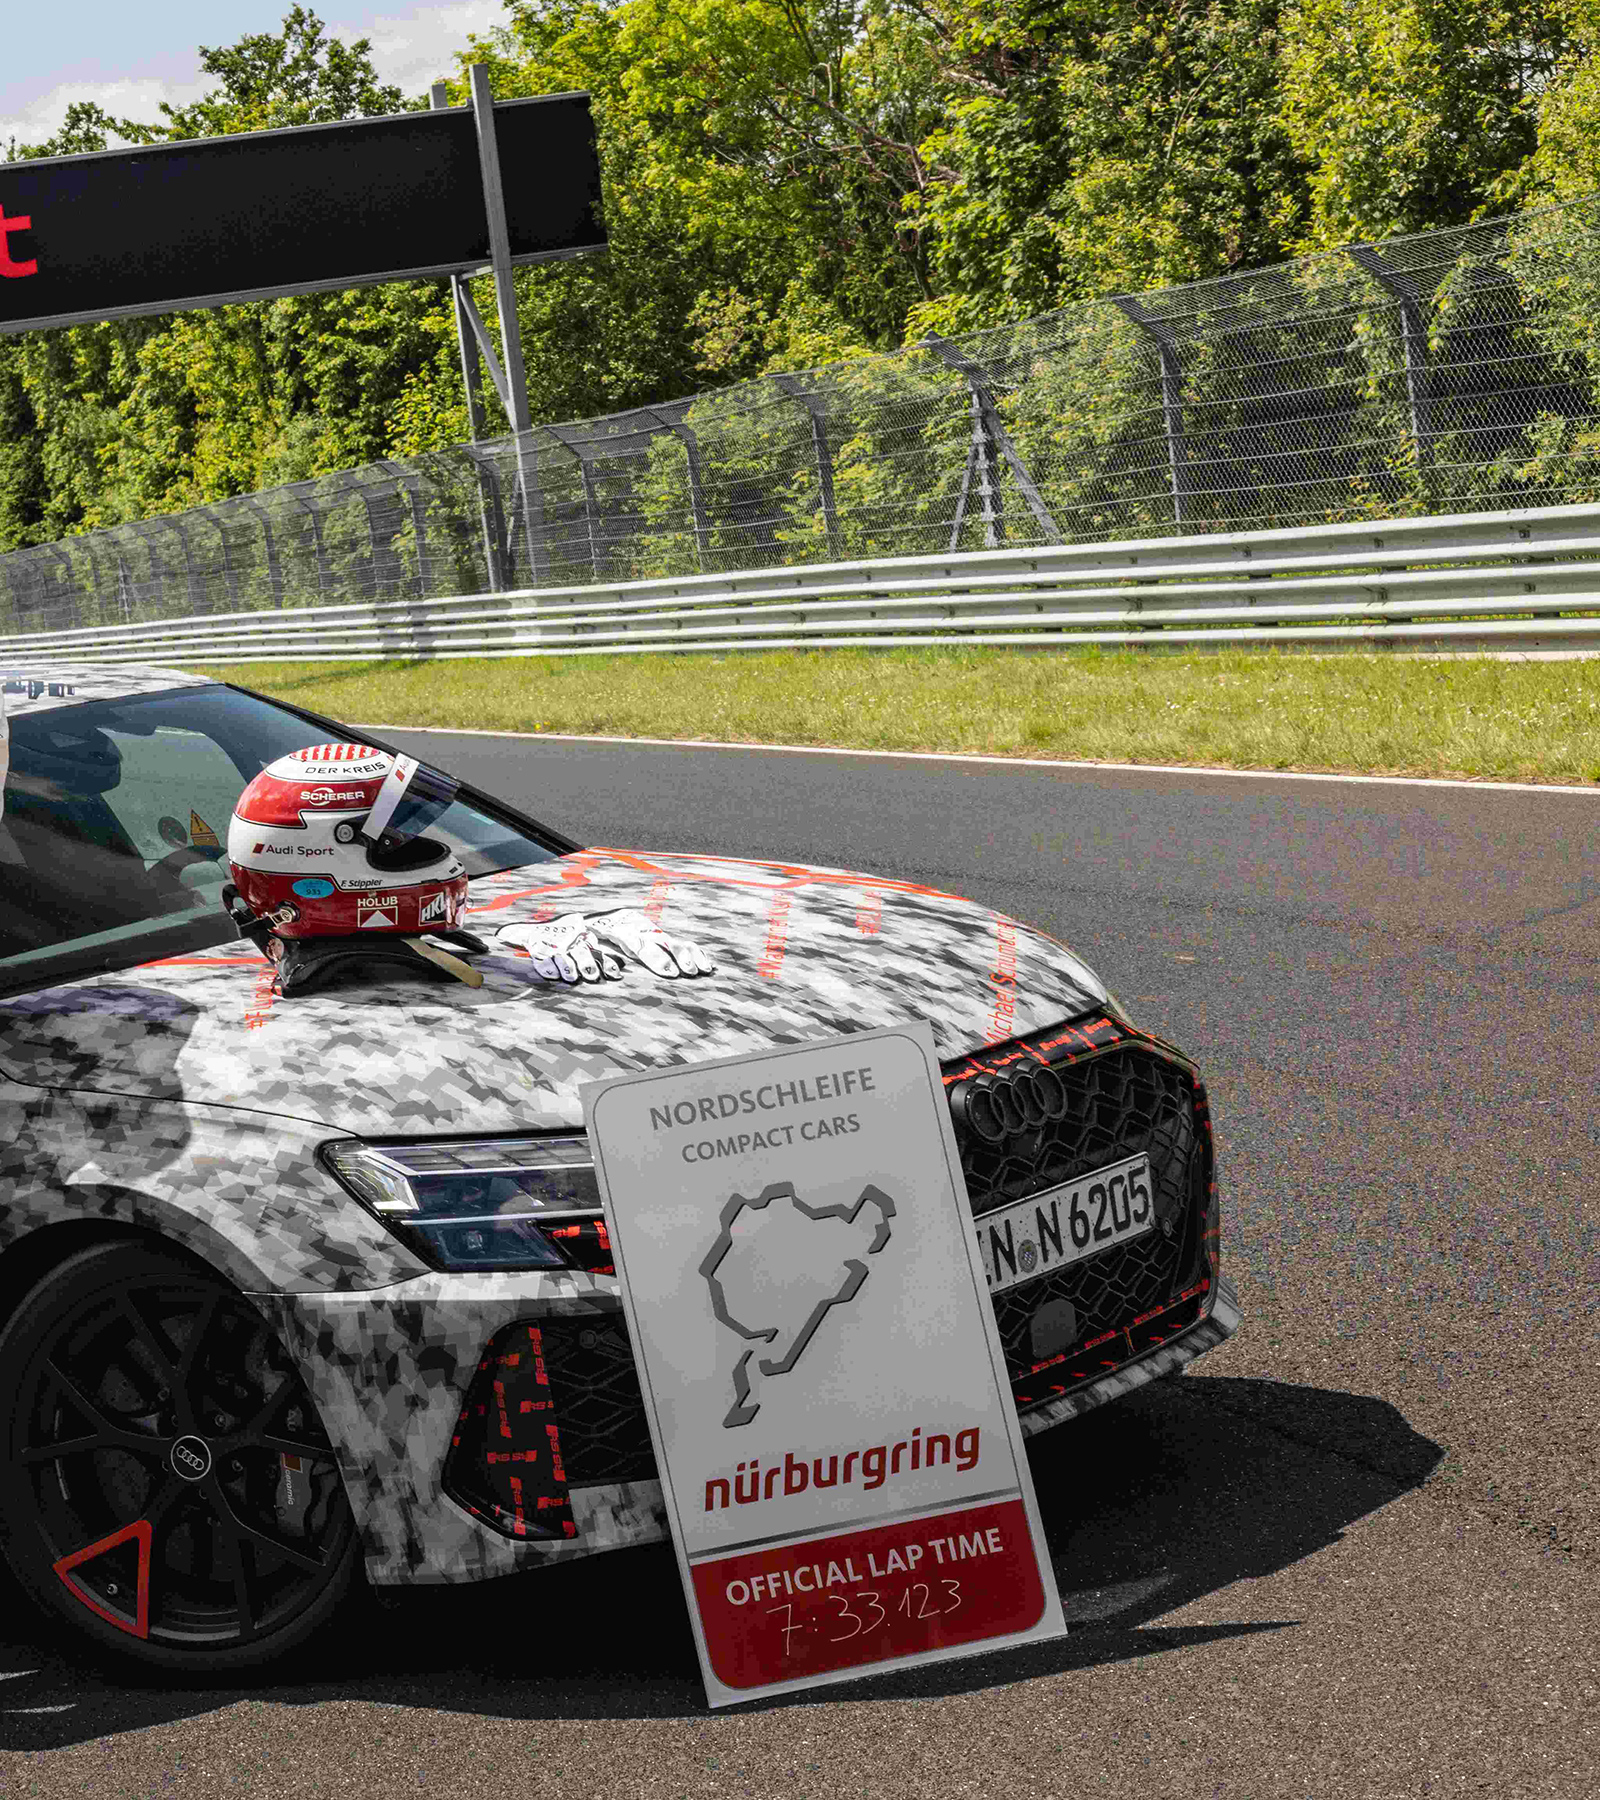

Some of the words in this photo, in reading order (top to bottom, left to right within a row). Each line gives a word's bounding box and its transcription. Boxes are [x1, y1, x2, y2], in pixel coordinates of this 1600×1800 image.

[305, 766, 338, 774] DER
[342, 762, 386, 774] KREIS
[300, 790, 365, 801] SCHERER
[266, 845, 293, 855] Audi
[297, 846, 334, 857] Sport
[348, 879, 383, 888] Stippler
[358, 896, 398, 908] HOLUB
[984, 986, 1015, 1046] Michael
[649, 1067, 876, 1131] NORDSCHLEIFE
[681, 1125, 796, 1164] COMPACT
[800, 1114, 861, 1142] CARS
[1036, 1201, 1064, 1263] N
[1070, 1166, 1150, 1248] 6205
[285, 1471, 294, 1505] ceramic
[704, 1427, 981, 1512] nürburgring
[726, 1560, 863, 1606] OFFICIAL
[867, 1545, 923, 1578] LAP
[928, 1527, 1004, 1565] TIME
